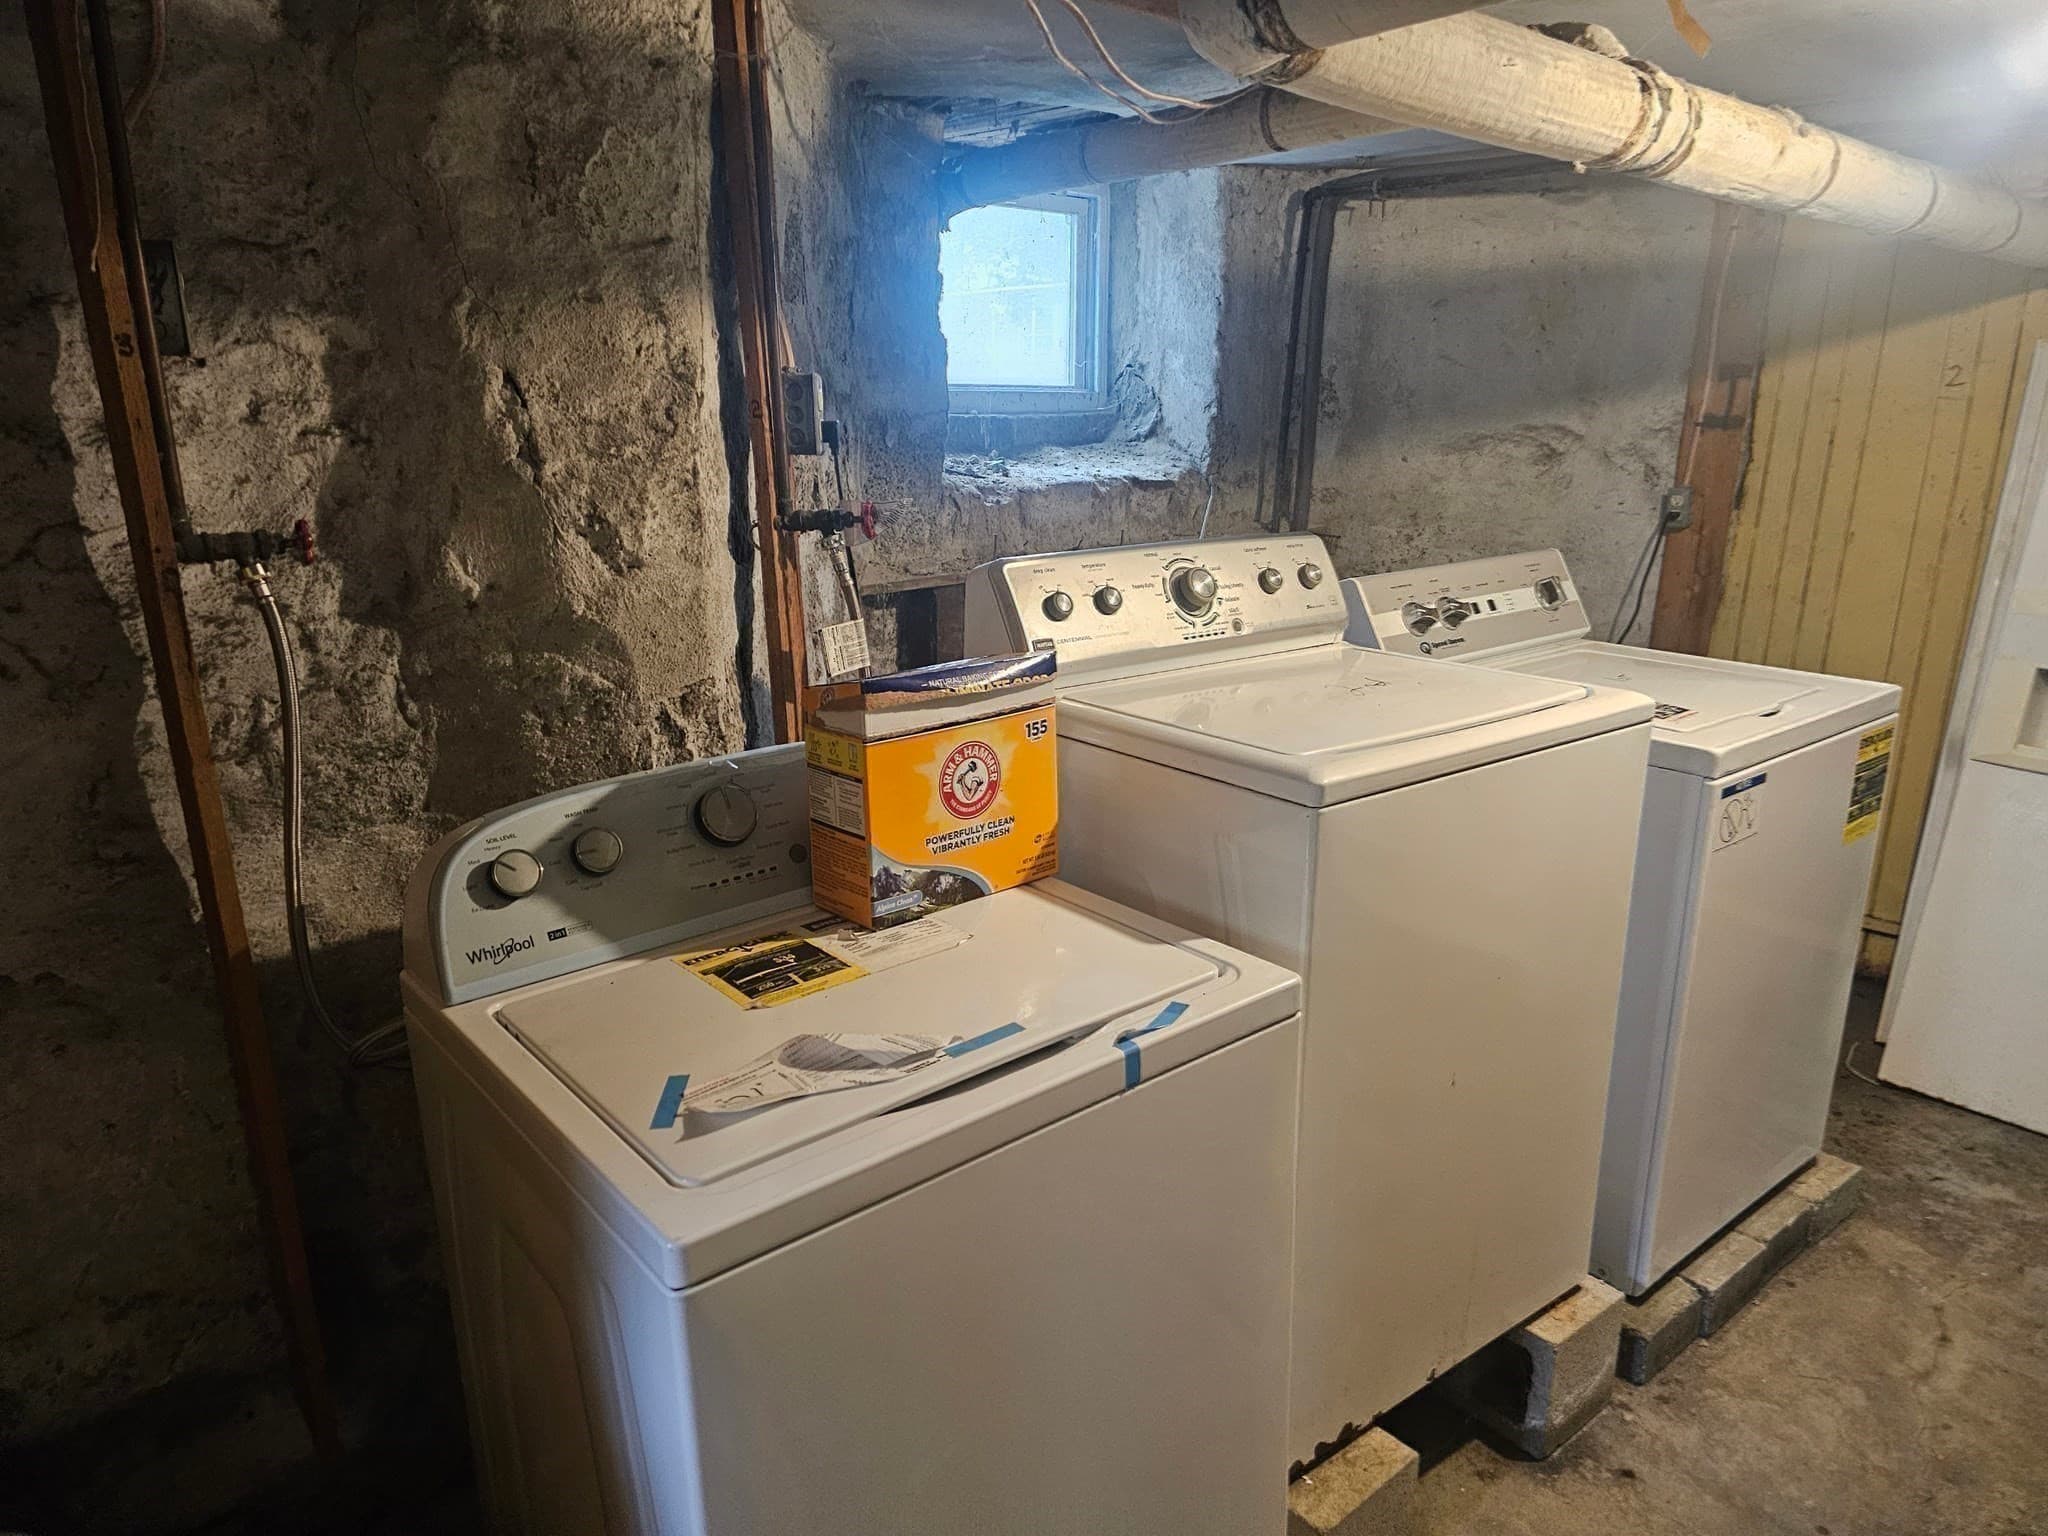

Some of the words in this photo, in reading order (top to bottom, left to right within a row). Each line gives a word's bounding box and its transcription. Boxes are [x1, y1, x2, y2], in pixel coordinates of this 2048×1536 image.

[1944, 364, 1967, 387] 2
[928, 676, 961, 688] NATURAL
[1025, 719, 1048, 738] 155
[943, 762, 955, 793] ARM
[953, 753, 964, 765] &
[963, 746, 998, 782] HAMMER
[500, 833, 518, 841] LEVEL
[925, 823, 986, 847] POWERFULLY
[987, 816, 1015, 830] CLEAN
[932, 835, 981, 855] VIBRANTLY
[983, 827, 1010, 841] FRESH
[465, 935, 535, 965] Whirlpool
